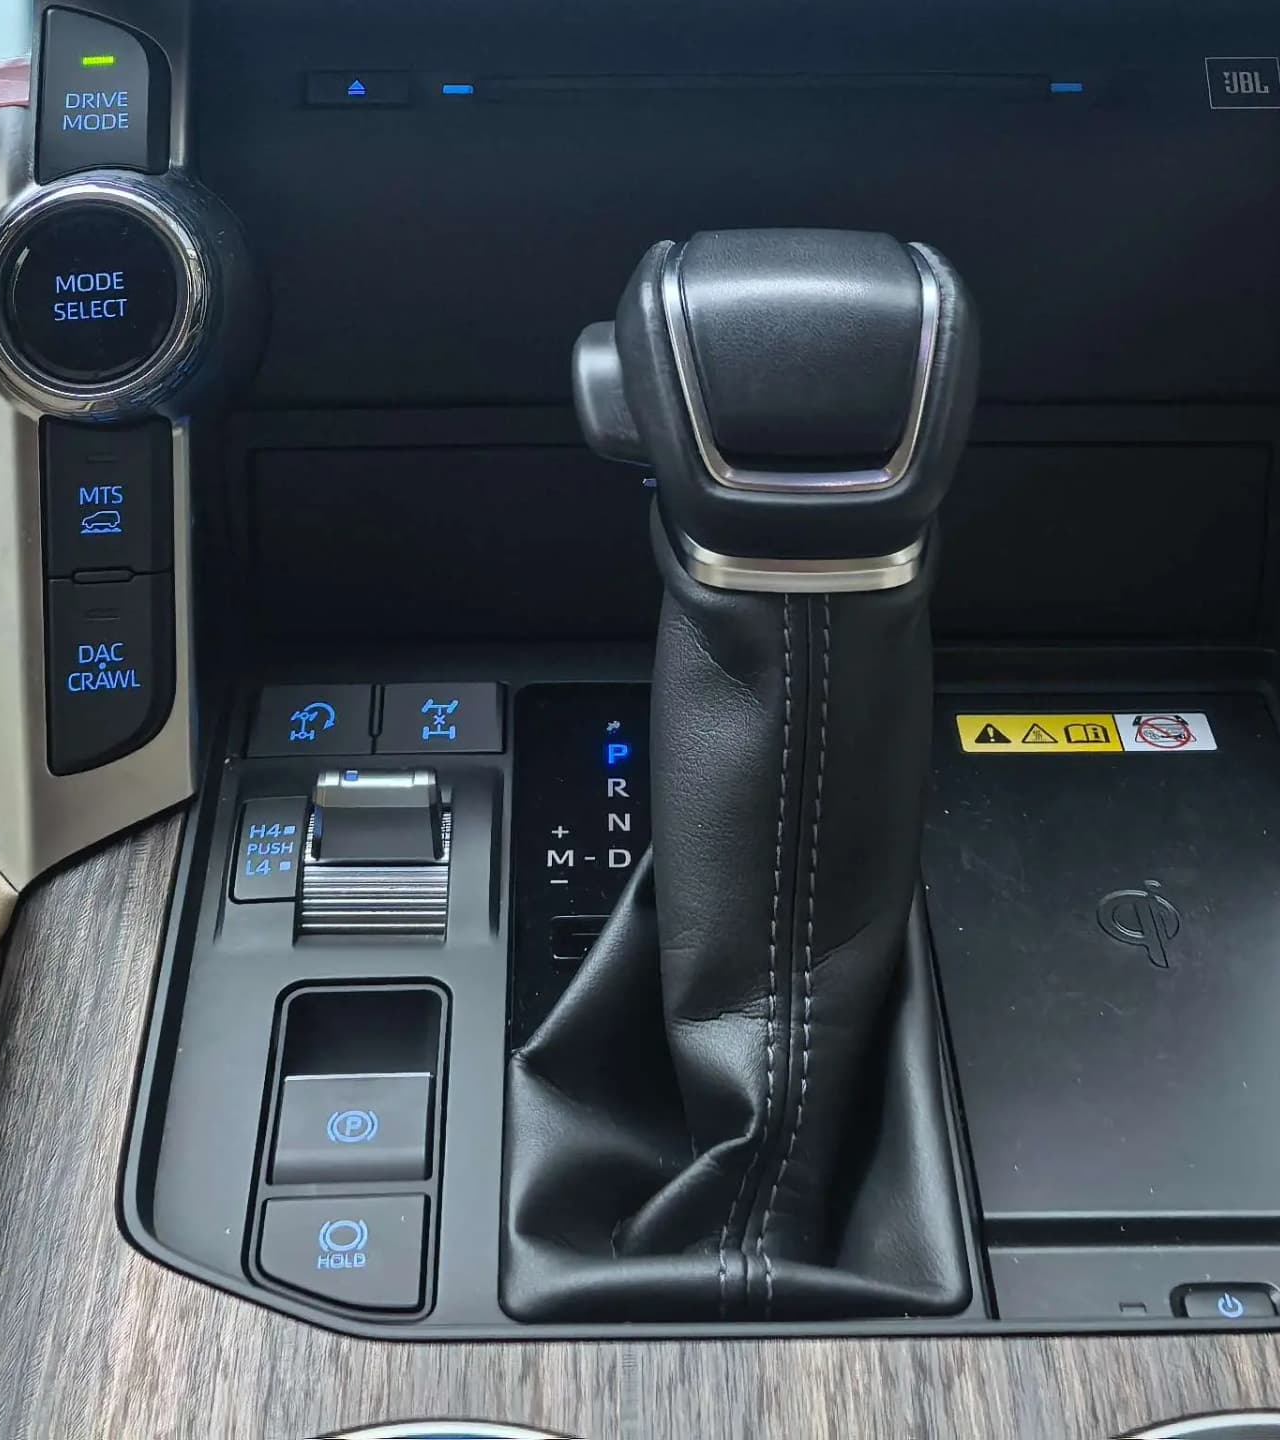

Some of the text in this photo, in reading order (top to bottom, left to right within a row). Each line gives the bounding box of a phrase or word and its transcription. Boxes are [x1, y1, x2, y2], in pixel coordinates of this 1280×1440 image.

[1224, 71, 1269, 93] JBL
[65, 91, 129, 110] DRIVE
[62, 113, 129, 131] MODE
[55, 271, 124, 294] MODE
[53, 298, 128, 321] SELECT
[79, 485, 124, 505] MTS
[78, 643, 125, 663] DAC
[67, 669, 142, 692] CRAWL
[606, 743, 630, 765] P
[607, 778, 629, 798] R
[249, 823, 282, 840] H4
[608, 813, 631, 833] N
[246, 841, 294, 856] PUSH
[547, 848, 632, 869] M D
[245, 860, 272, 877] L4
[317, 1254, 366, 1269] HOLD
